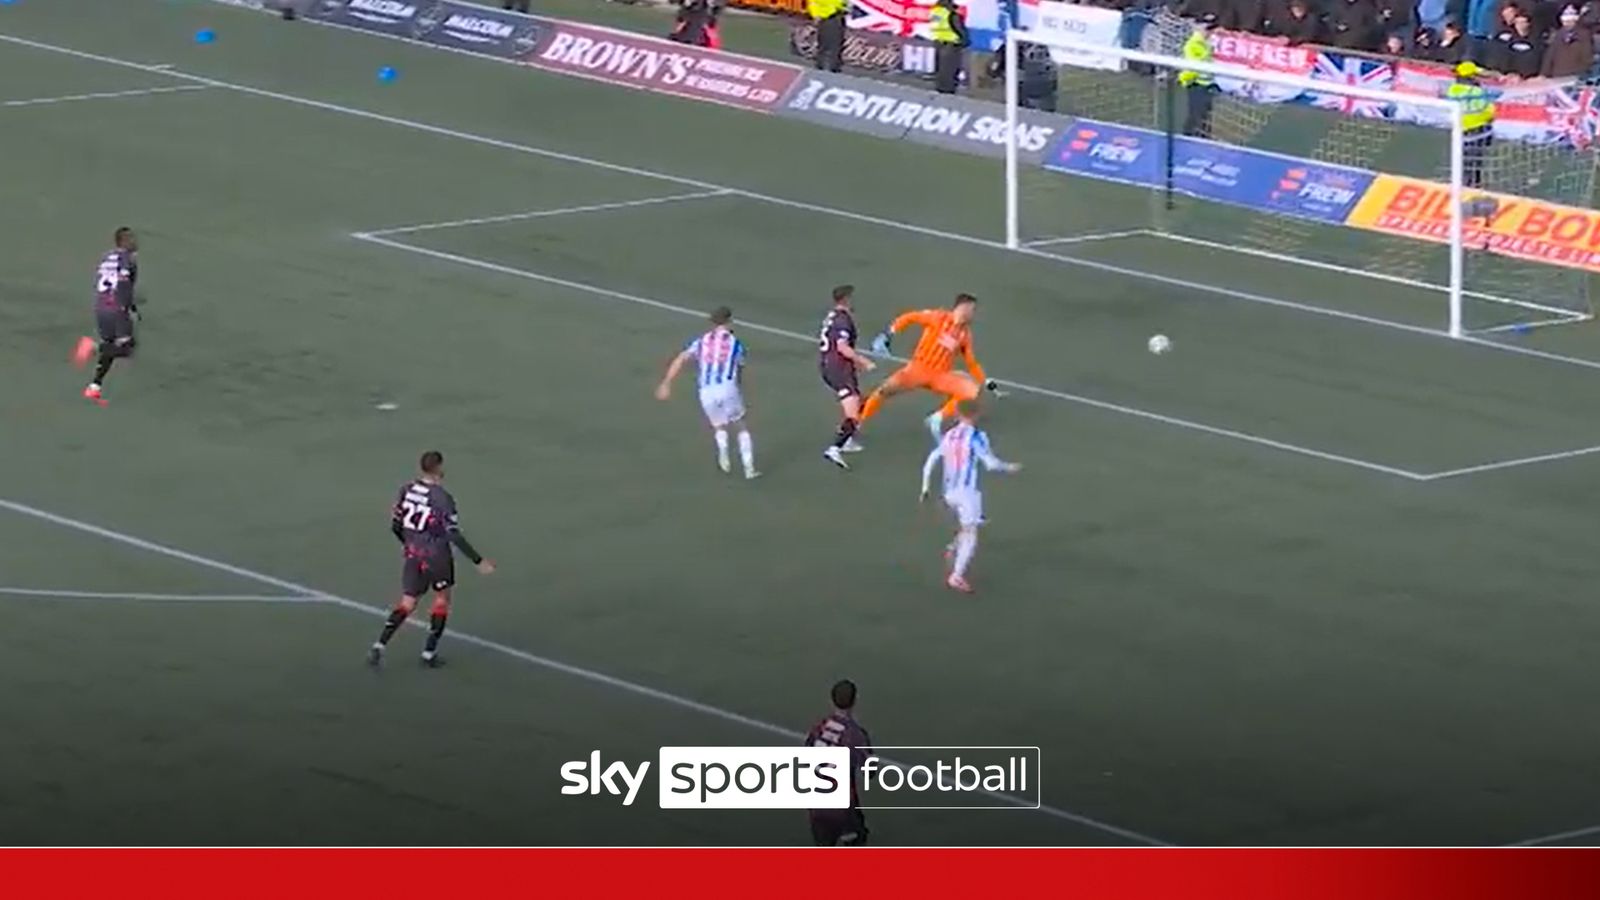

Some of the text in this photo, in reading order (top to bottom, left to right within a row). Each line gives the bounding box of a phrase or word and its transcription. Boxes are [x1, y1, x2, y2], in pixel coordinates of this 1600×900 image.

[540, 32, 695, 85] BROWN'S
[814, 86, 1054, 151] CENTURION SIGNS
[1297, 181, 1356, 205] FREW
[402, 500, 431, 531] 27
